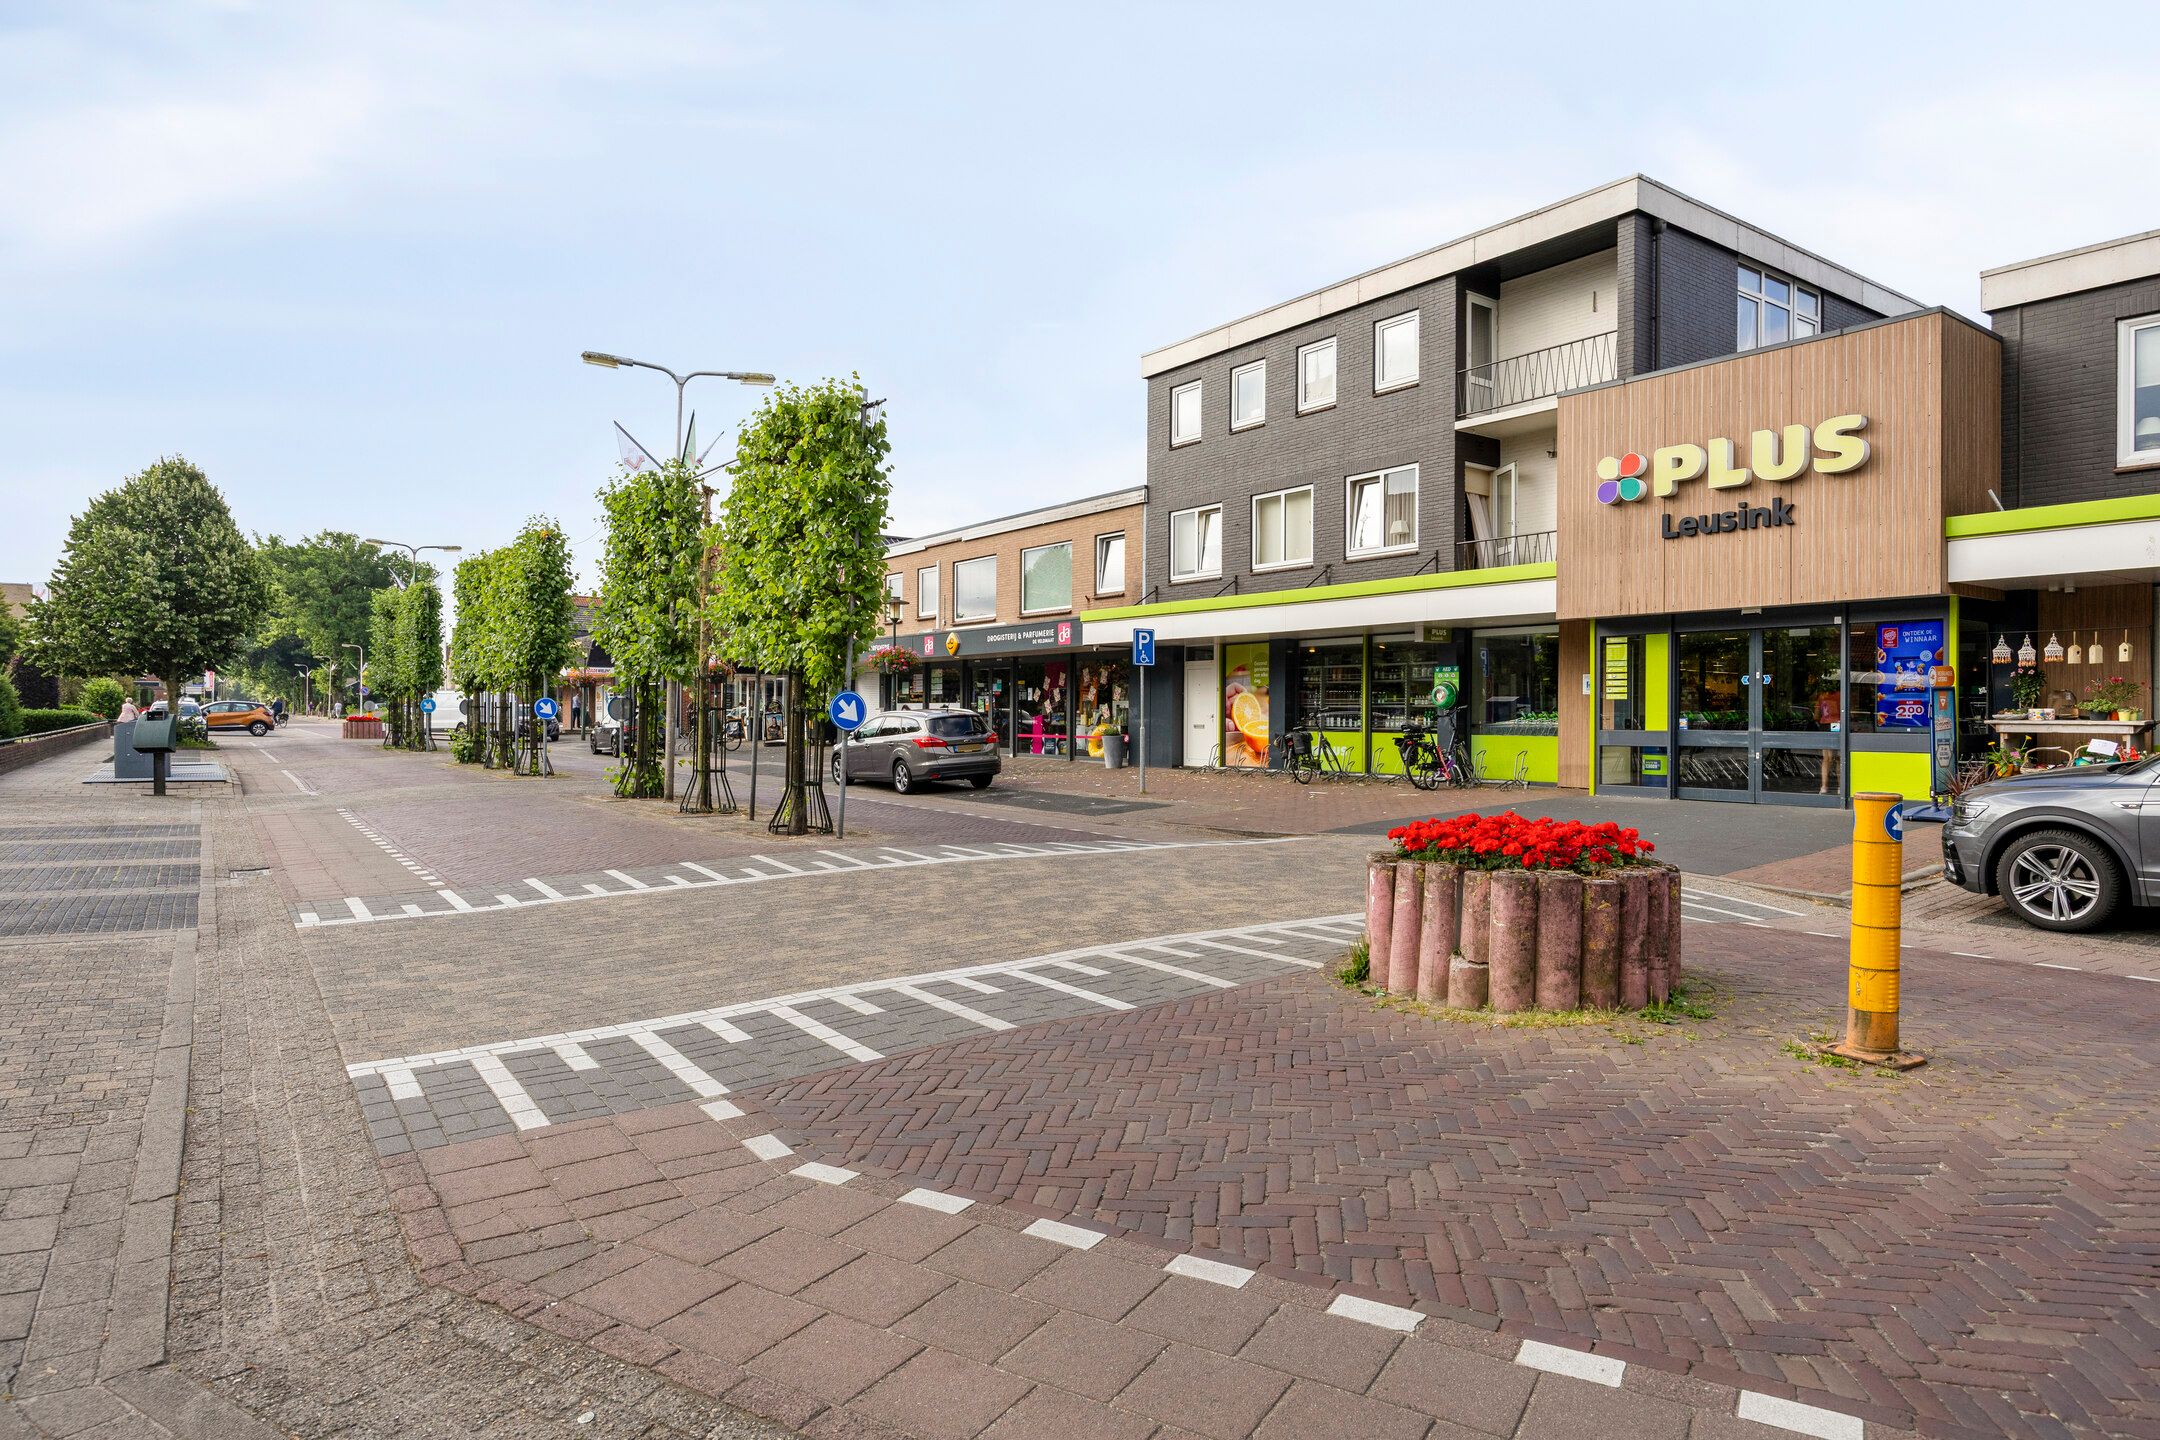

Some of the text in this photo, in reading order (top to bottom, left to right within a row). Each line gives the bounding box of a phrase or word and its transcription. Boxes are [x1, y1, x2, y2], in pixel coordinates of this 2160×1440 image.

[1653, 414, 1870, 498] PLUS
[1662, 497, 1795, 539] Leusink
[1022, 628, 1054, 639] PARFUMERIE
[1058, 626, 1070, 642] da
[1431, 628, 1447, 636] PLUS
[1904, 635, 1937, 643] WINNAAR
[1138, 632, 1150, 650] P
